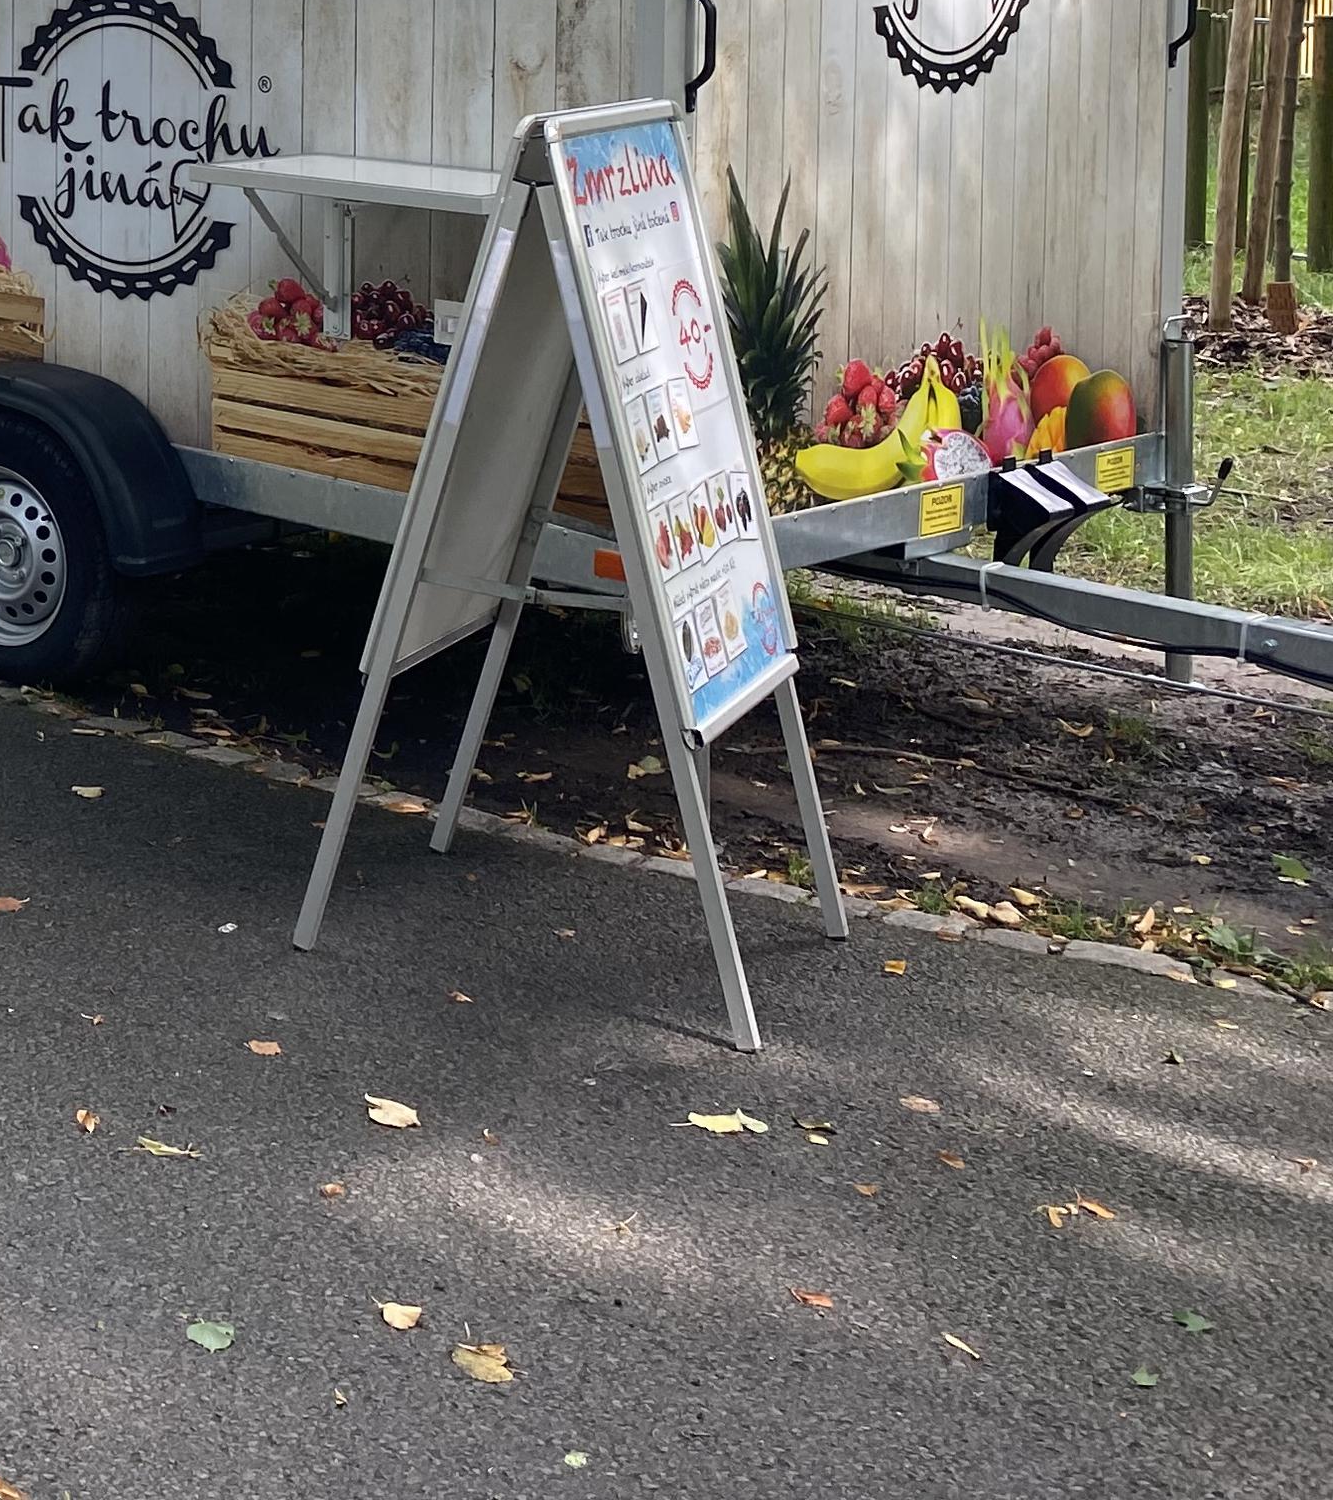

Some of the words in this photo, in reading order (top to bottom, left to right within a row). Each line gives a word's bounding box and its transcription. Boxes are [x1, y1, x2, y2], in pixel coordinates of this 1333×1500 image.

[95, 79, 281, 163] trochu
[54, 153, 172, 219] jiná
[566, 142, 676, 206] Zmrzlina
